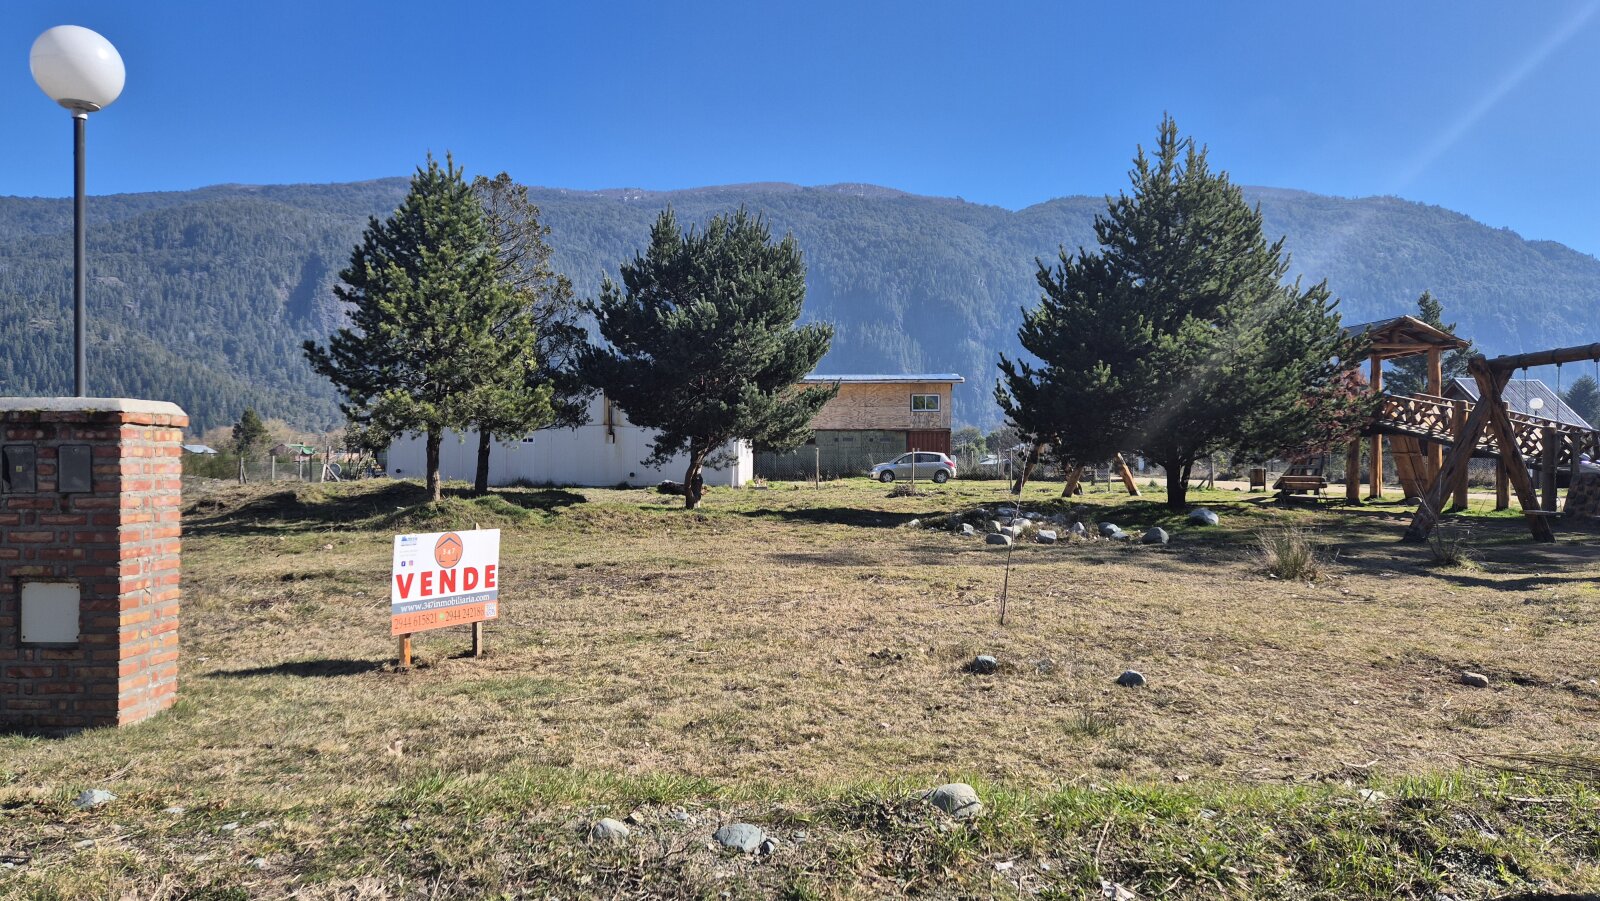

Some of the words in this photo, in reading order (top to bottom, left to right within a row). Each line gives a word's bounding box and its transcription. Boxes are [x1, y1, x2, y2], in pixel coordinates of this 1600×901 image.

[395, 564, 496, 599] VENDE
[400, 594, 490, 613] www.347inmobiliaria.com
[394, 617, 412, 630] 2944
[445, 609, 461, 622] 2944
